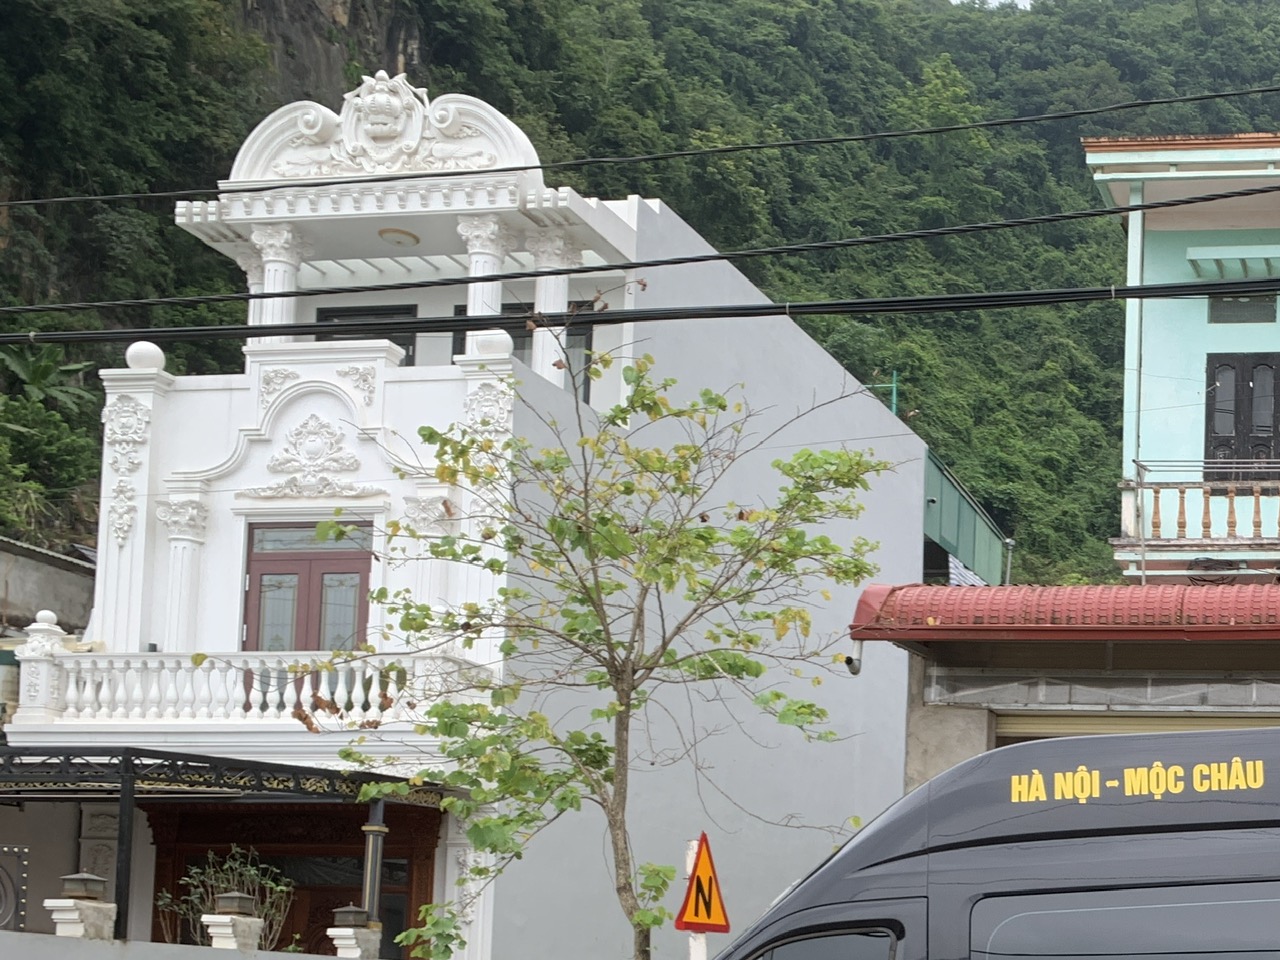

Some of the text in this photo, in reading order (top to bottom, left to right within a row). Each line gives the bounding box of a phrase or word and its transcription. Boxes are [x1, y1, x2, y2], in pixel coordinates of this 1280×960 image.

[1011, 769, 1047, 803] HÀ
[1054, 765, 1100, 804] NỘI
[1124, 761, 1185, 800] MỘC
[1192, 756, 1265, 793] CHÂU
[694, 875, 713, 920] N
